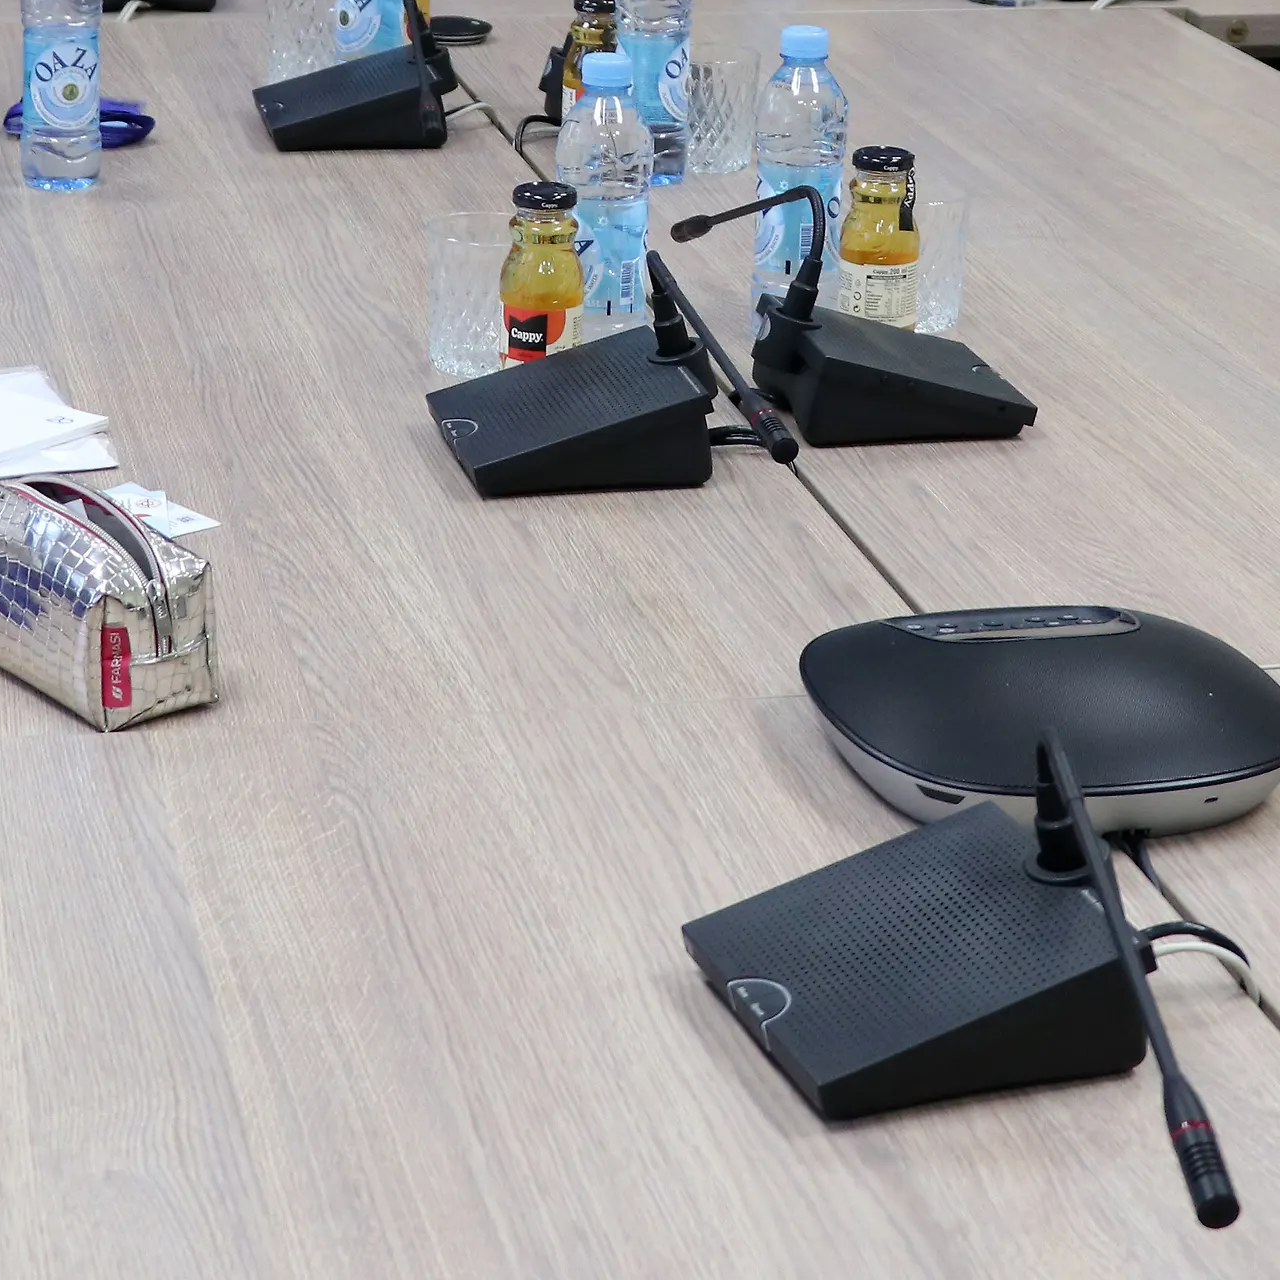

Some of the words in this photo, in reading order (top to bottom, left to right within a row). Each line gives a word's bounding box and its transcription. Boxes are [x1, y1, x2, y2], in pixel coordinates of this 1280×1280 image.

[35, 47, 98, 82] OAZA
[904, 166, 916, 208] Cappy
[541, 202, 558, 210] Cappy
[511, 327, 544, 343] Cappy
